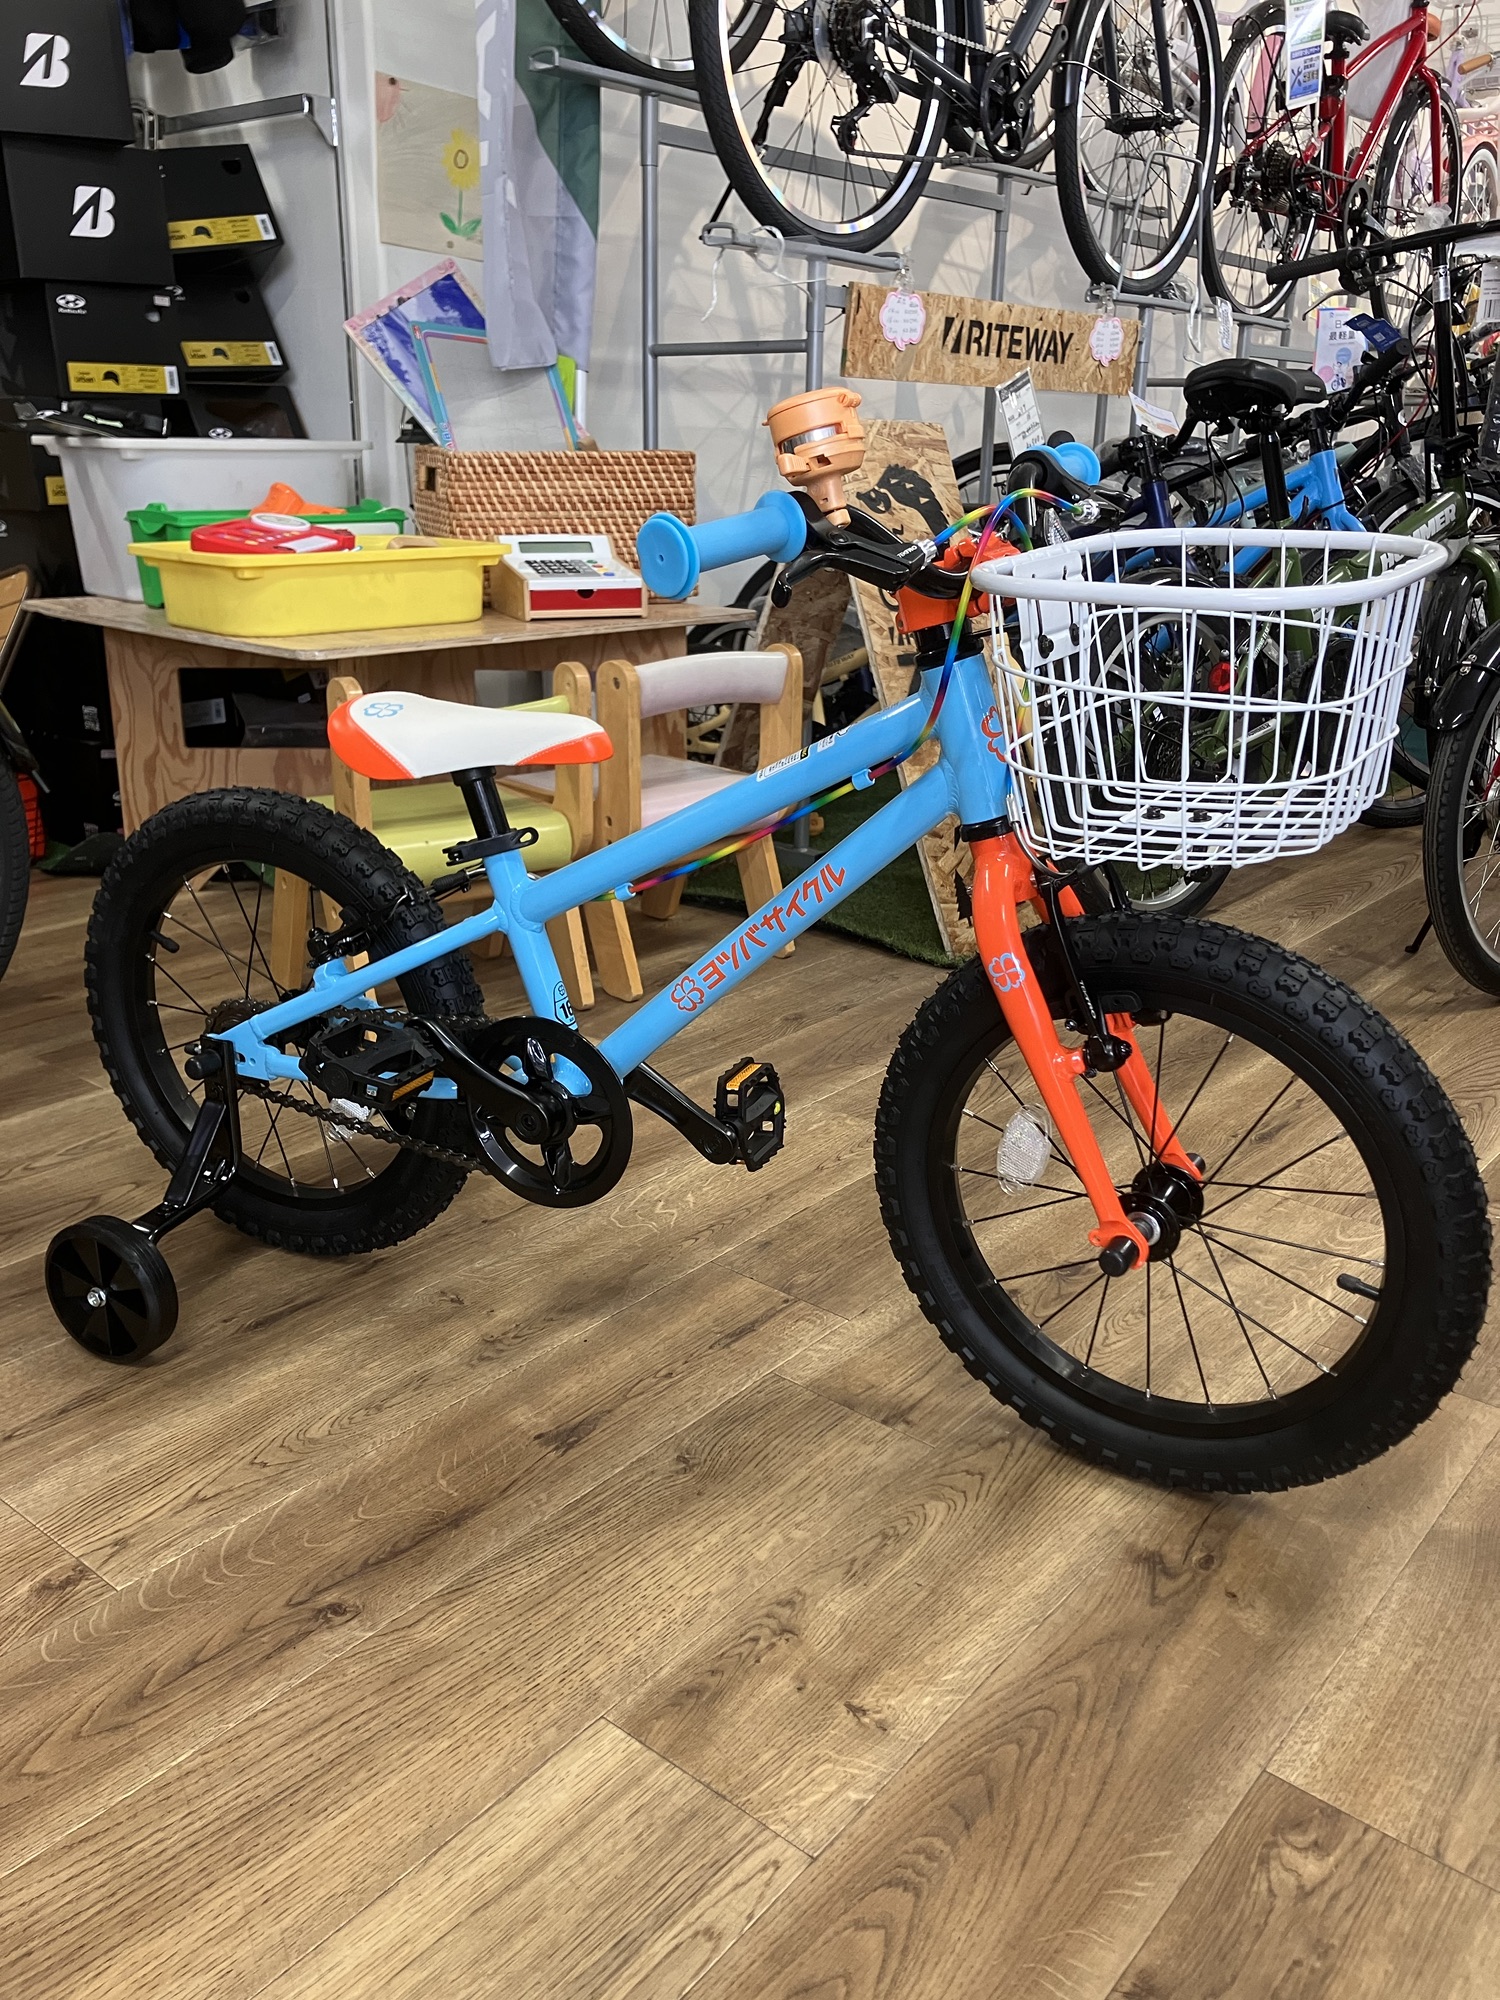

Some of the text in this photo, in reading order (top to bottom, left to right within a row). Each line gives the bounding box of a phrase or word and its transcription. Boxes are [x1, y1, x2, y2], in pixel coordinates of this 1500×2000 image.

[965, 319, 1075, 365] RITEWAY
[697, 863, 847, 991] ヨツバサイクル
